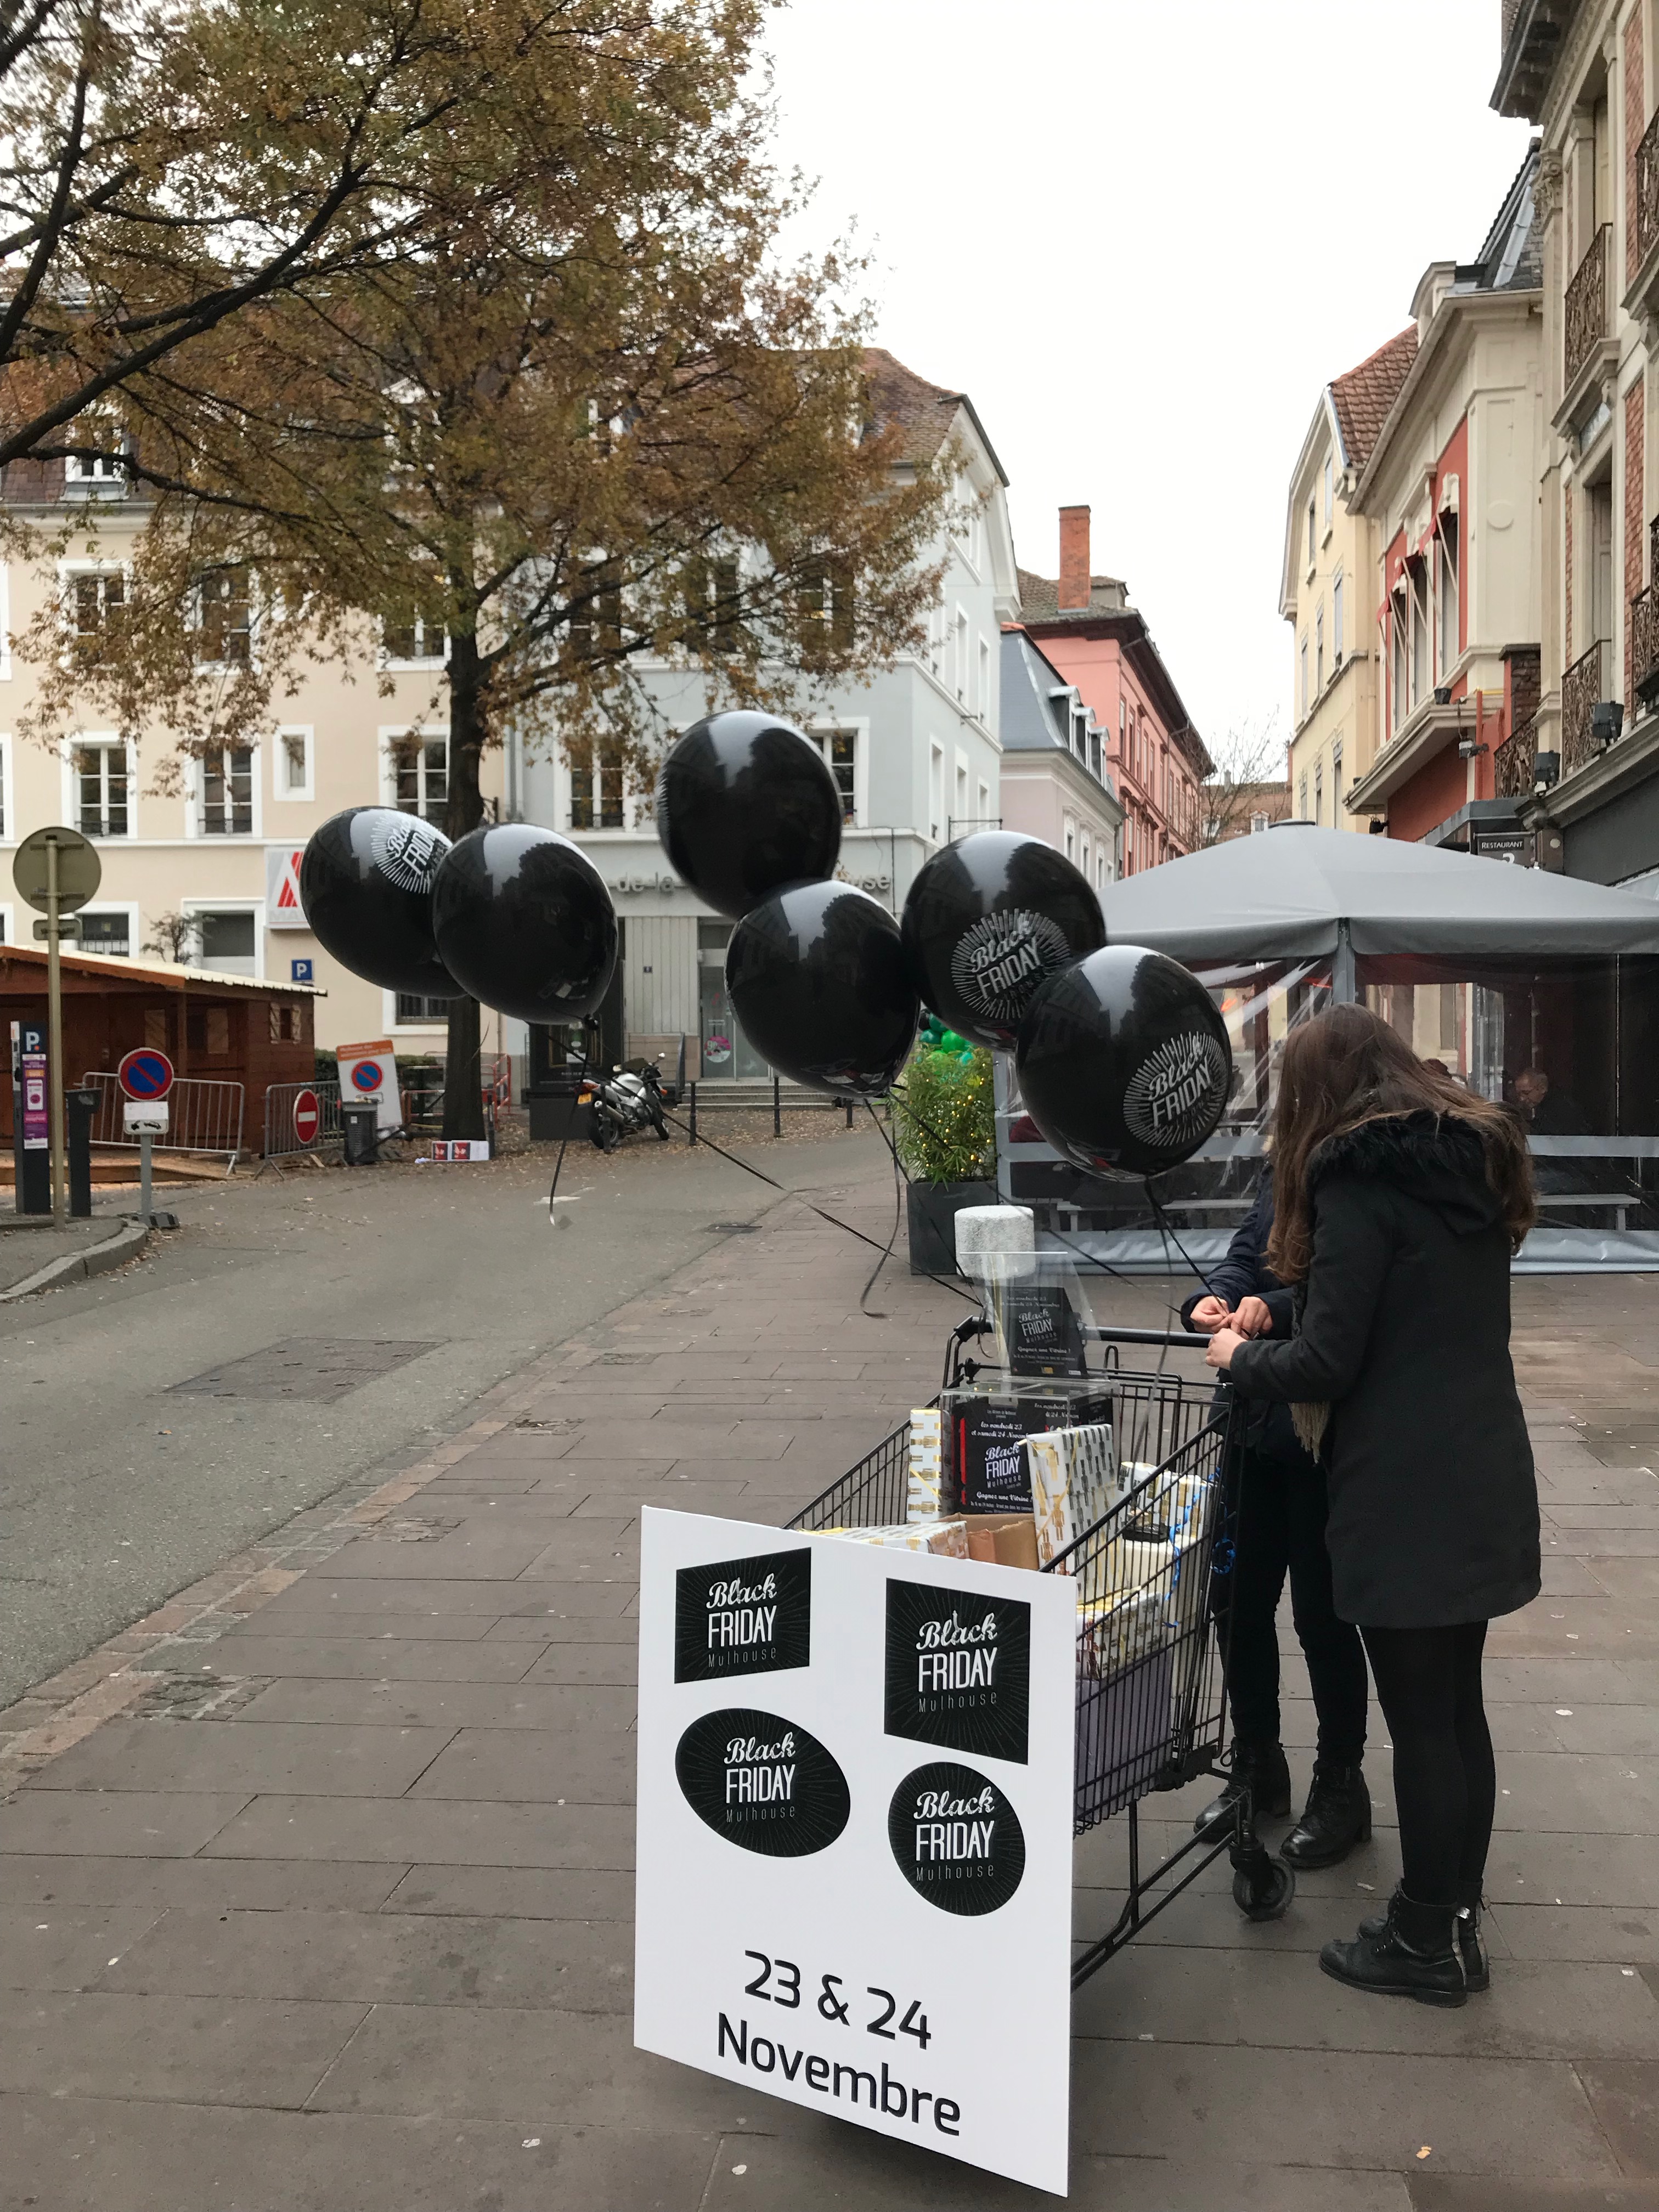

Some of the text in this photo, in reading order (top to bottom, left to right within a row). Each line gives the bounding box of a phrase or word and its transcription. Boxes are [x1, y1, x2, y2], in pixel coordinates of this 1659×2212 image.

[1481, 840, 1523, 849] RESTAURANT
[616, 872, 644, 892] de
[655, 871, 674, 892] la
[970, 913, 1032, 973] Black
[297, 962, 307, 978] P
[977, 936, 1041, 1000] FRIDAY
[1148, 1035, 1203, 1100] Black
[1153, 1056, 1211, 1127] FRIDAY
[1018, 1308, 1050, 1323] Black
[1021, 1318, 1053, 1336] FRIDAY
[1026, 1331, 1057, 1344] Mulhouse
[985, 1441, 1020, 1461] Black
[986, 1455, 1020, 1480] FRIDAY
[988, 1475, 1022, 1488] Mulhouse
[977, 1491, 997, 1500] Gagnez
[1009, 1494, 1029, 1502] Vitrine
[706, 1573, 777, 1609] Black
[708, 1605, 777, 1649] FRIDAY
[916, 1611, 998, 1650] Black
[708, 1647, 776, 1667] Mulhouse
[918, 1647, 998, 1692] FRIDAY
[919, 1692, 997, 1713] Mulhouse
[724, 1731, 795, 1764] Black
[726, 1764, 795, 1804] FRIDAY
[726, 1806, 795, 1823] Mulhouse
[913, 1786, 995, 1820] Black
[916, 1820, 995, 1861] FRIDAY
[916, 1864, 994, 1882] Mulhouse
[745, 1950, 932, 2050] 23 & 24
[718, 2012, 960, 2136] Novembre
